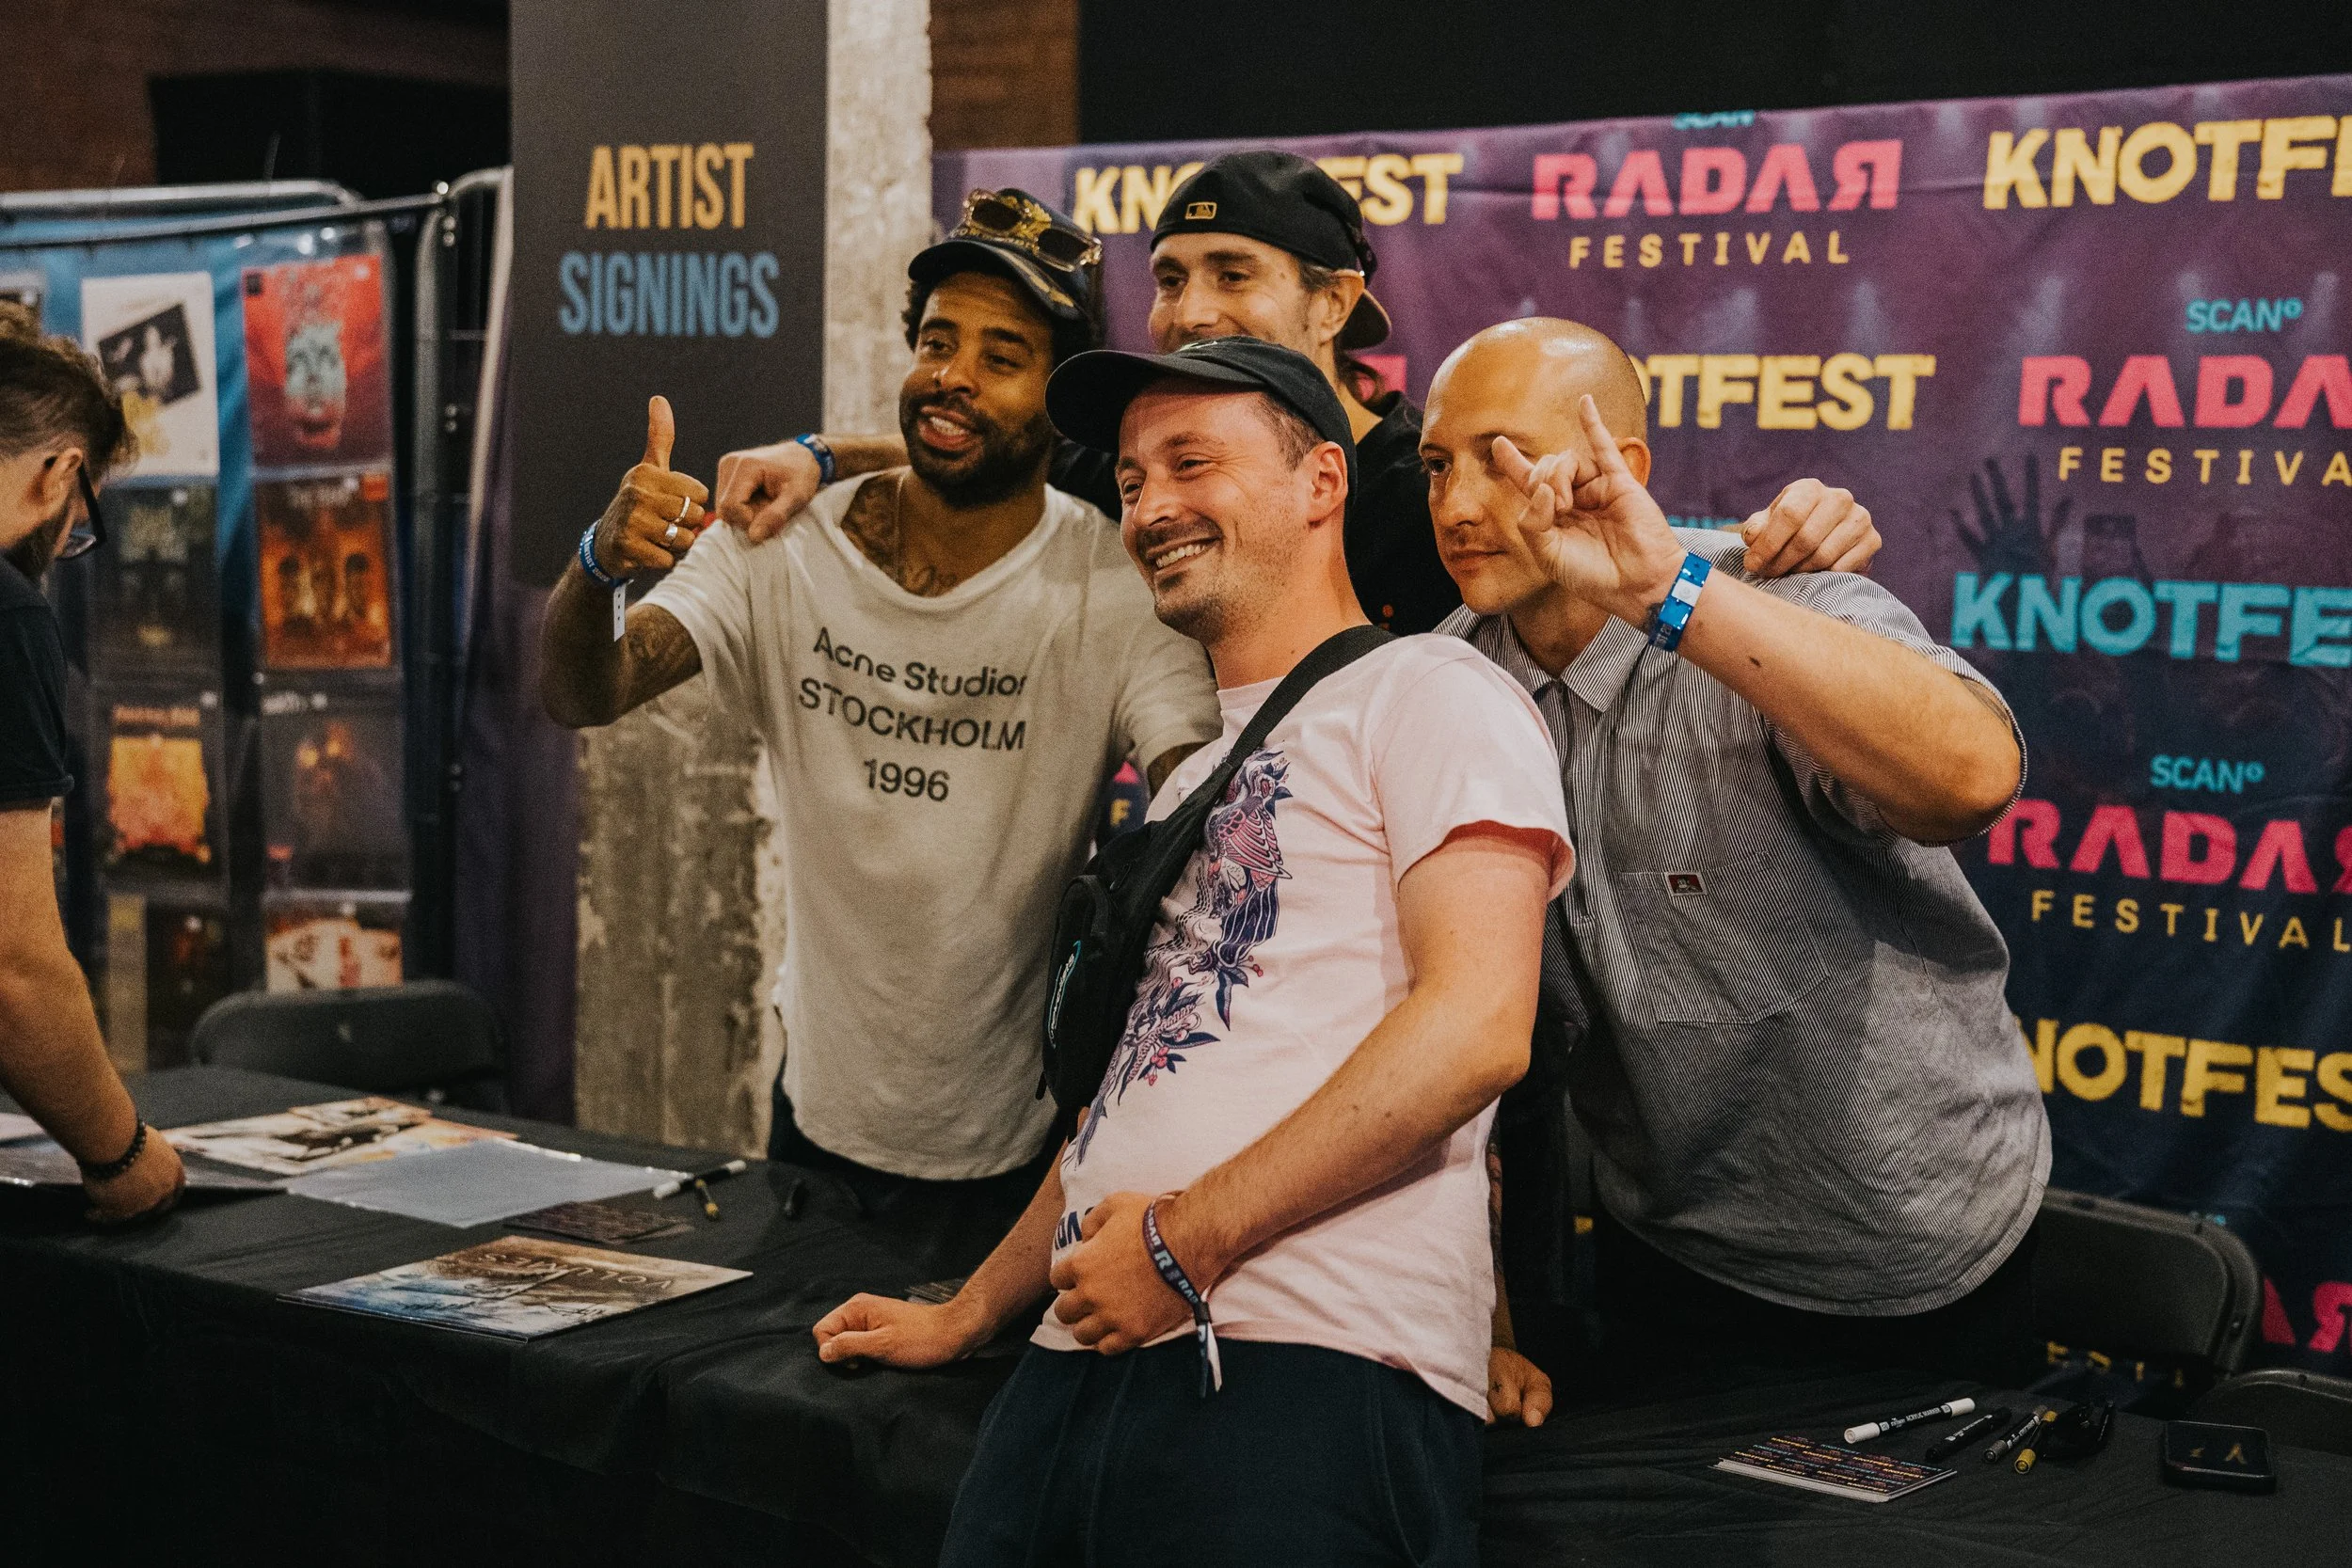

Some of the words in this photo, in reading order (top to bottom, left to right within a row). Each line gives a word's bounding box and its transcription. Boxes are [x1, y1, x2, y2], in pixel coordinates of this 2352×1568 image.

[584, 143, 754, 229] ARTIST
[1568, 230, 1849, 268] FESTIVAL
[559, 251, 780, 338] SIGNINGS
[1629, 353, 1936, 430] TFEST
[2058, 446, 2352, 485] FESTIVA
[813, 626, 896, 682] Acne
[1951, 572, 2352, 668] KNOTFE
[799, 678, 1026, 751] STOCKHOLM
[864, 758, 950, 801] 1996
[2032, 890, 2351, 953] FESTIVAL
